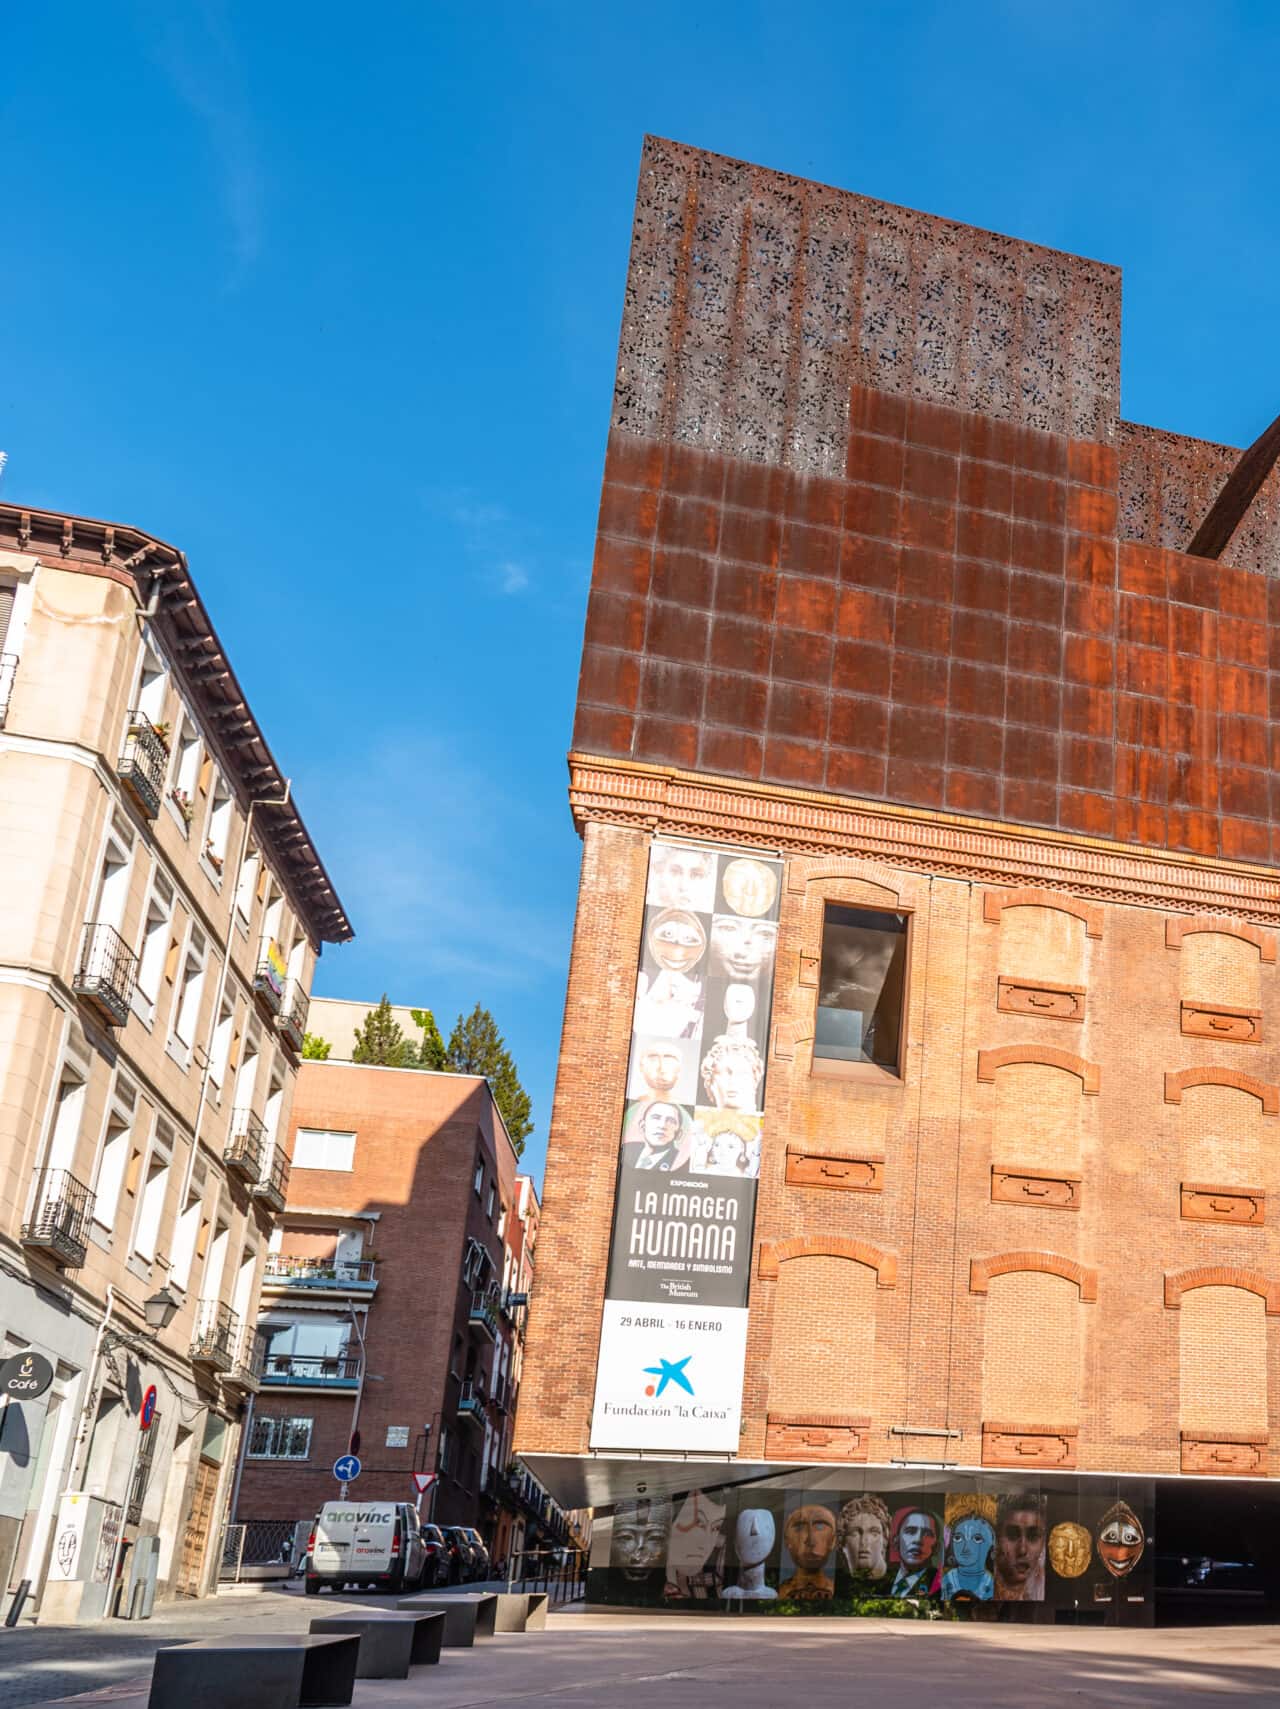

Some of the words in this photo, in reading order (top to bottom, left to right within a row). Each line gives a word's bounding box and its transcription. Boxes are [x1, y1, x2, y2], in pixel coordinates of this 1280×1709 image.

[634, 1191, 657, 1215] LA
[662, 1193, 738, 1221] IMAGEN
[629, 1218, 737, 1261] HUMANA
[668, 1290, 699, 1298] Museum
[669, 1282, 692, 1291] British
[620, 1317, 632, 1327] 29
[634, 1318, 665, 1329] ABRIL
[675, 1320, 686, 1330] 16
[688, 1321, 723, 1332] ENERO
[8, 1378, 38, 1390] Café
[603, 1402, 671, 1417] Fundación
